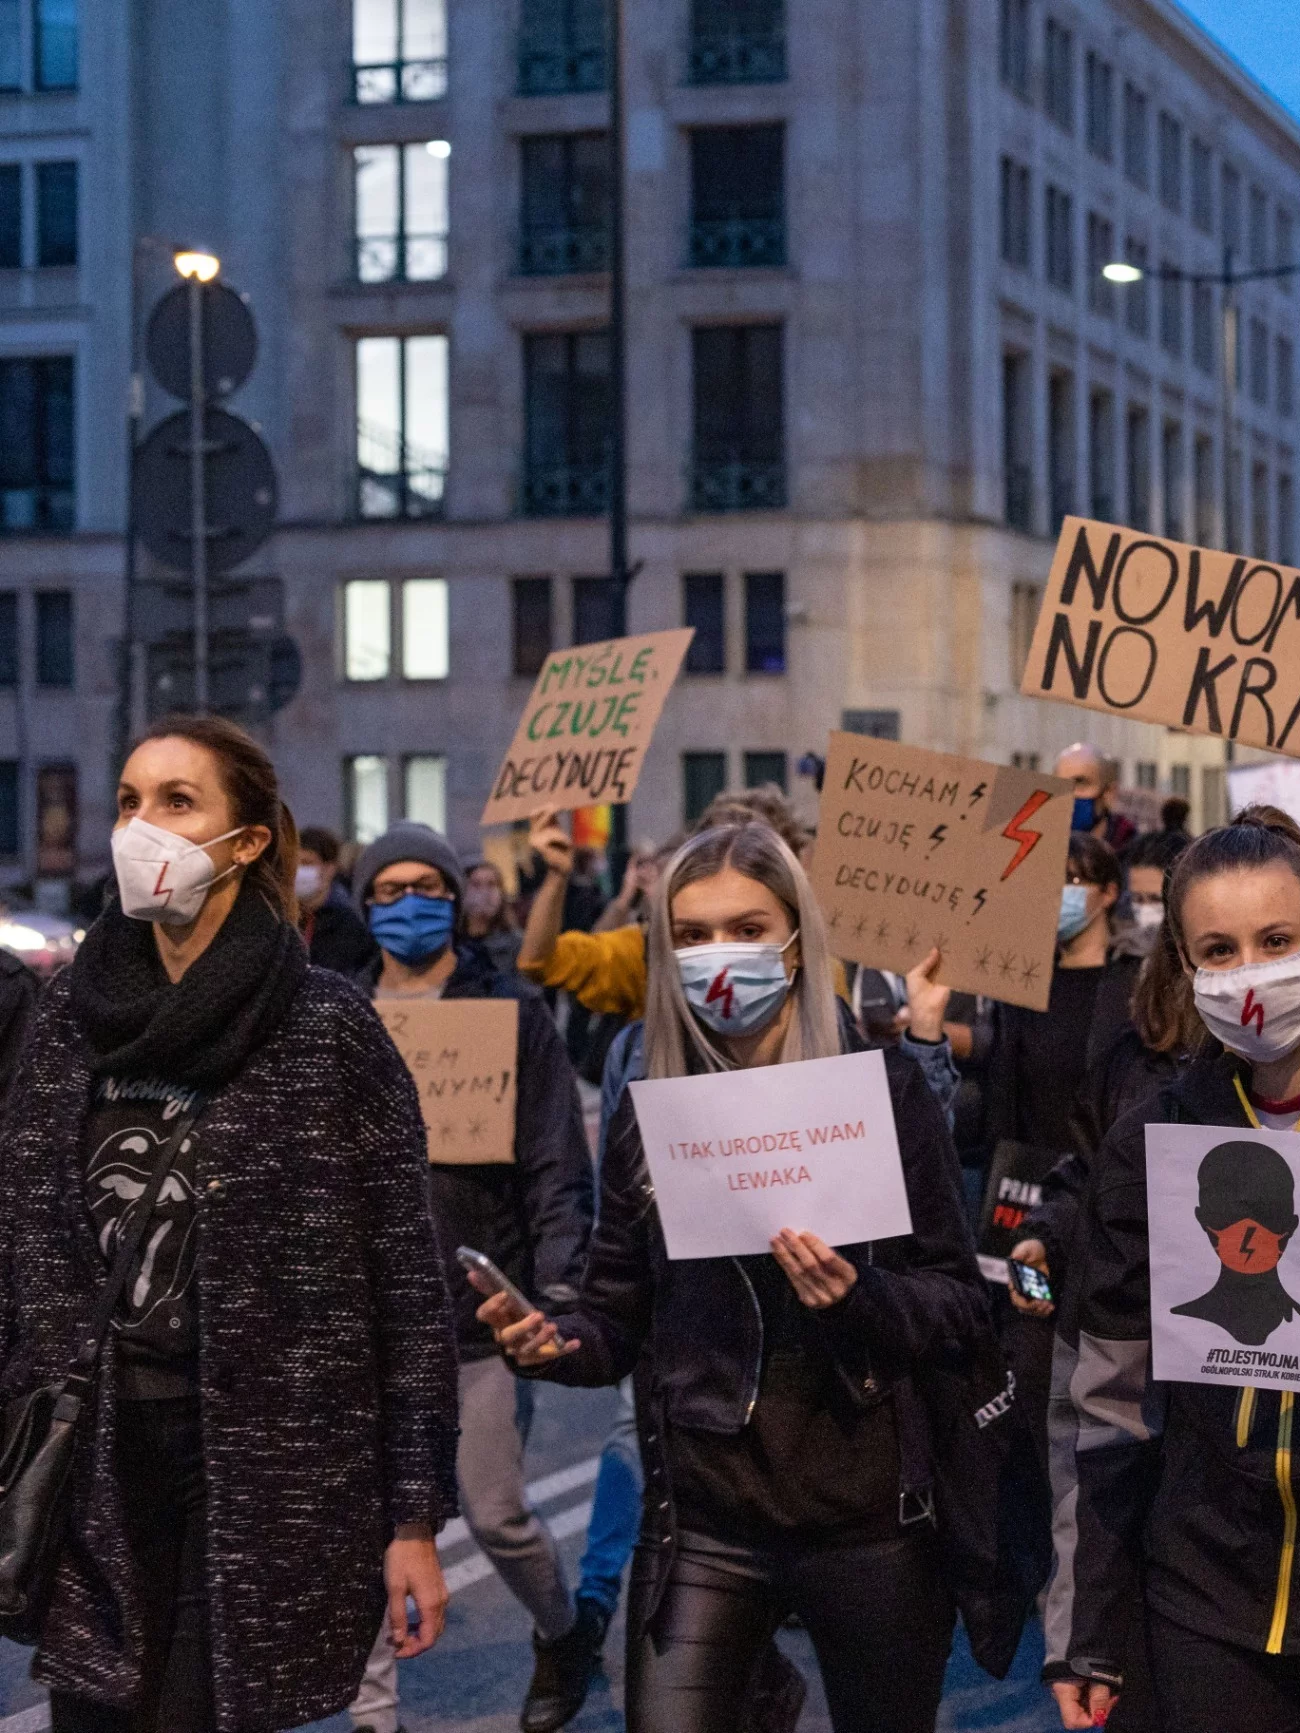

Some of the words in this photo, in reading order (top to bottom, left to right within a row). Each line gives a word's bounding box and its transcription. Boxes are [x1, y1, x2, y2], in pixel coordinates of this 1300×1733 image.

[1041, 612, 1157, 709] NO
[494, 745, 638, 800] DECYDUJĘ
[681, 1140, 716, 1161] TAK
[719, 1130, 804, 1157] URODZĘ
[805, 1120, 866, 1146] WAM
[727, 1165, 813, 1191] LEWAKA
[1200, 1365, 1253, 1377] OGÓLNOPOLSKI
[1253, 1369, 1281, 1380] STRAJK
[1206, 1348, 1300, 1370] #TOJESTWOJNA
